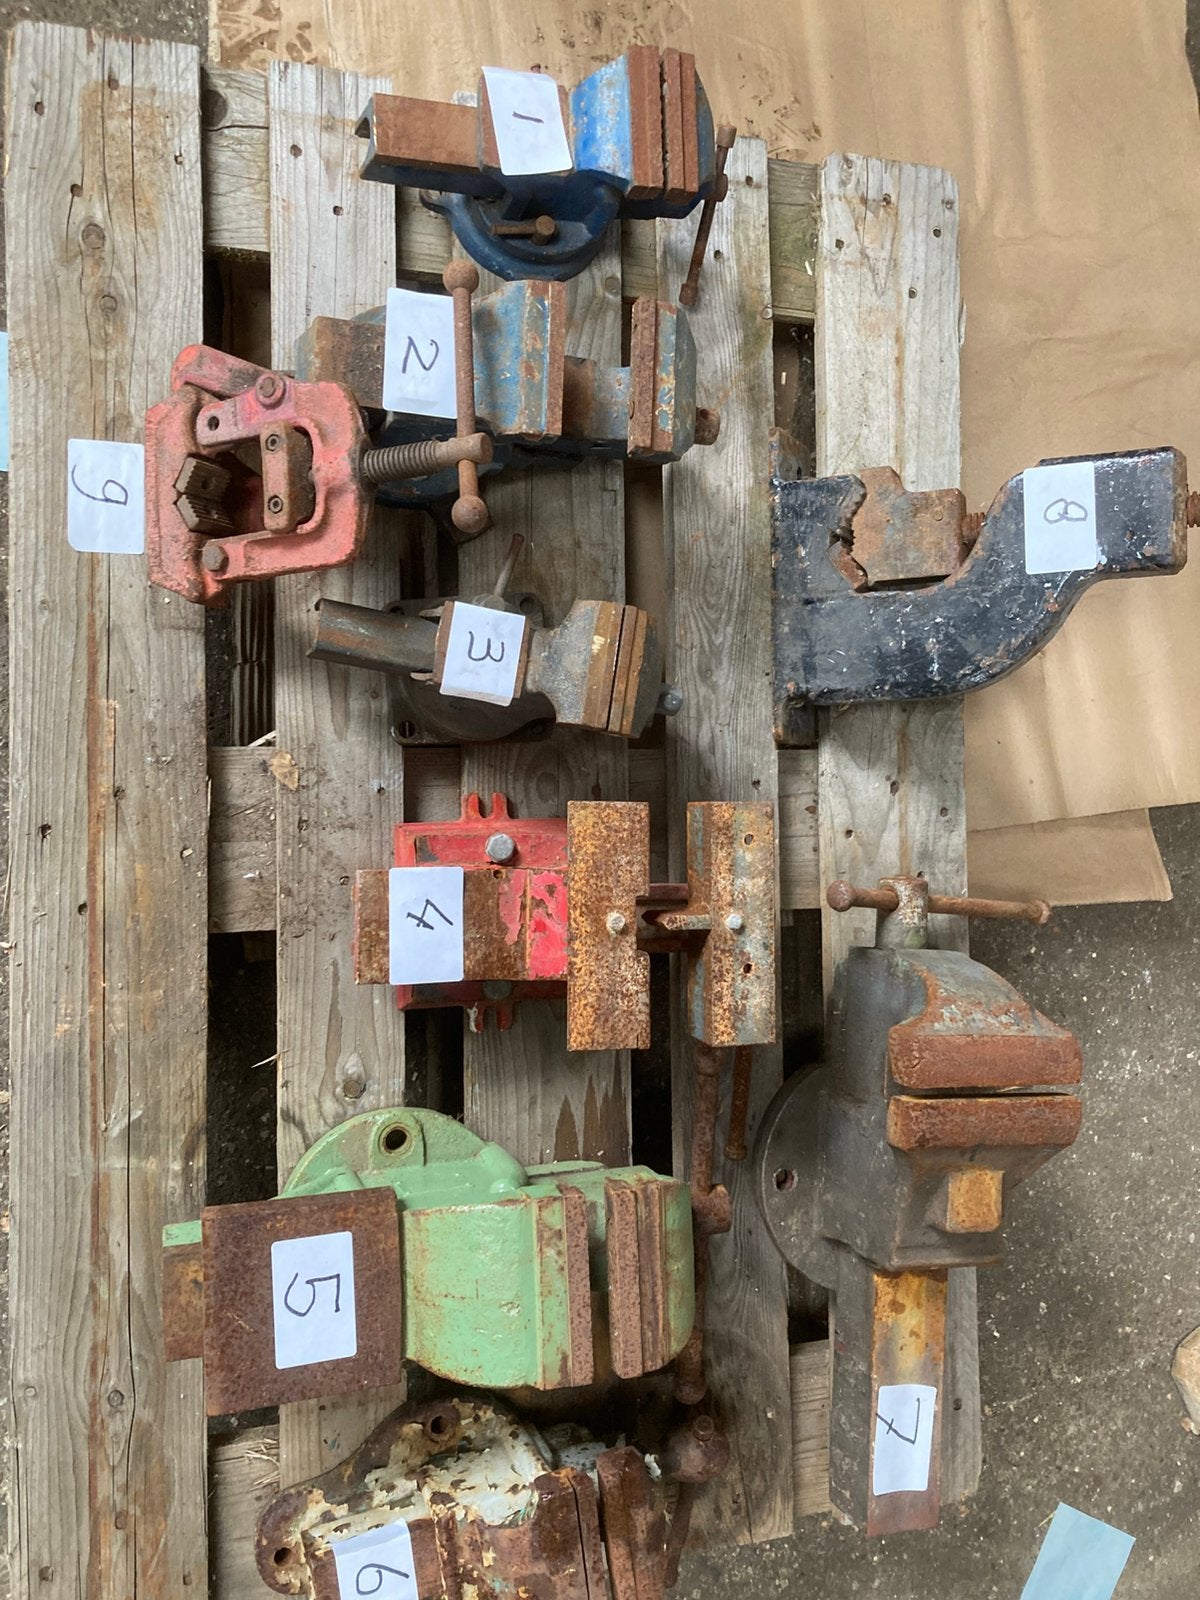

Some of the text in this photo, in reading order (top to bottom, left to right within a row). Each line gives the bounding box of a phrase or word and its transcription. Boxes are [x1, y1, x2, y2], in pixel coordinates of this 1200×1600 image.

[511, 111, 545, 124] 1
[402, 336, 440, 375] 2
[71, 465, 129, 507] 9
[1043, 497, 1089, 524] 8
[467, 631, 506, 663] 3
[406, 898, 454, 931] 4
[284, 1272, 341, 1318] 5
[875, 1397, 921, 1446] 7
[356, 1562, 410, 1597] 6
